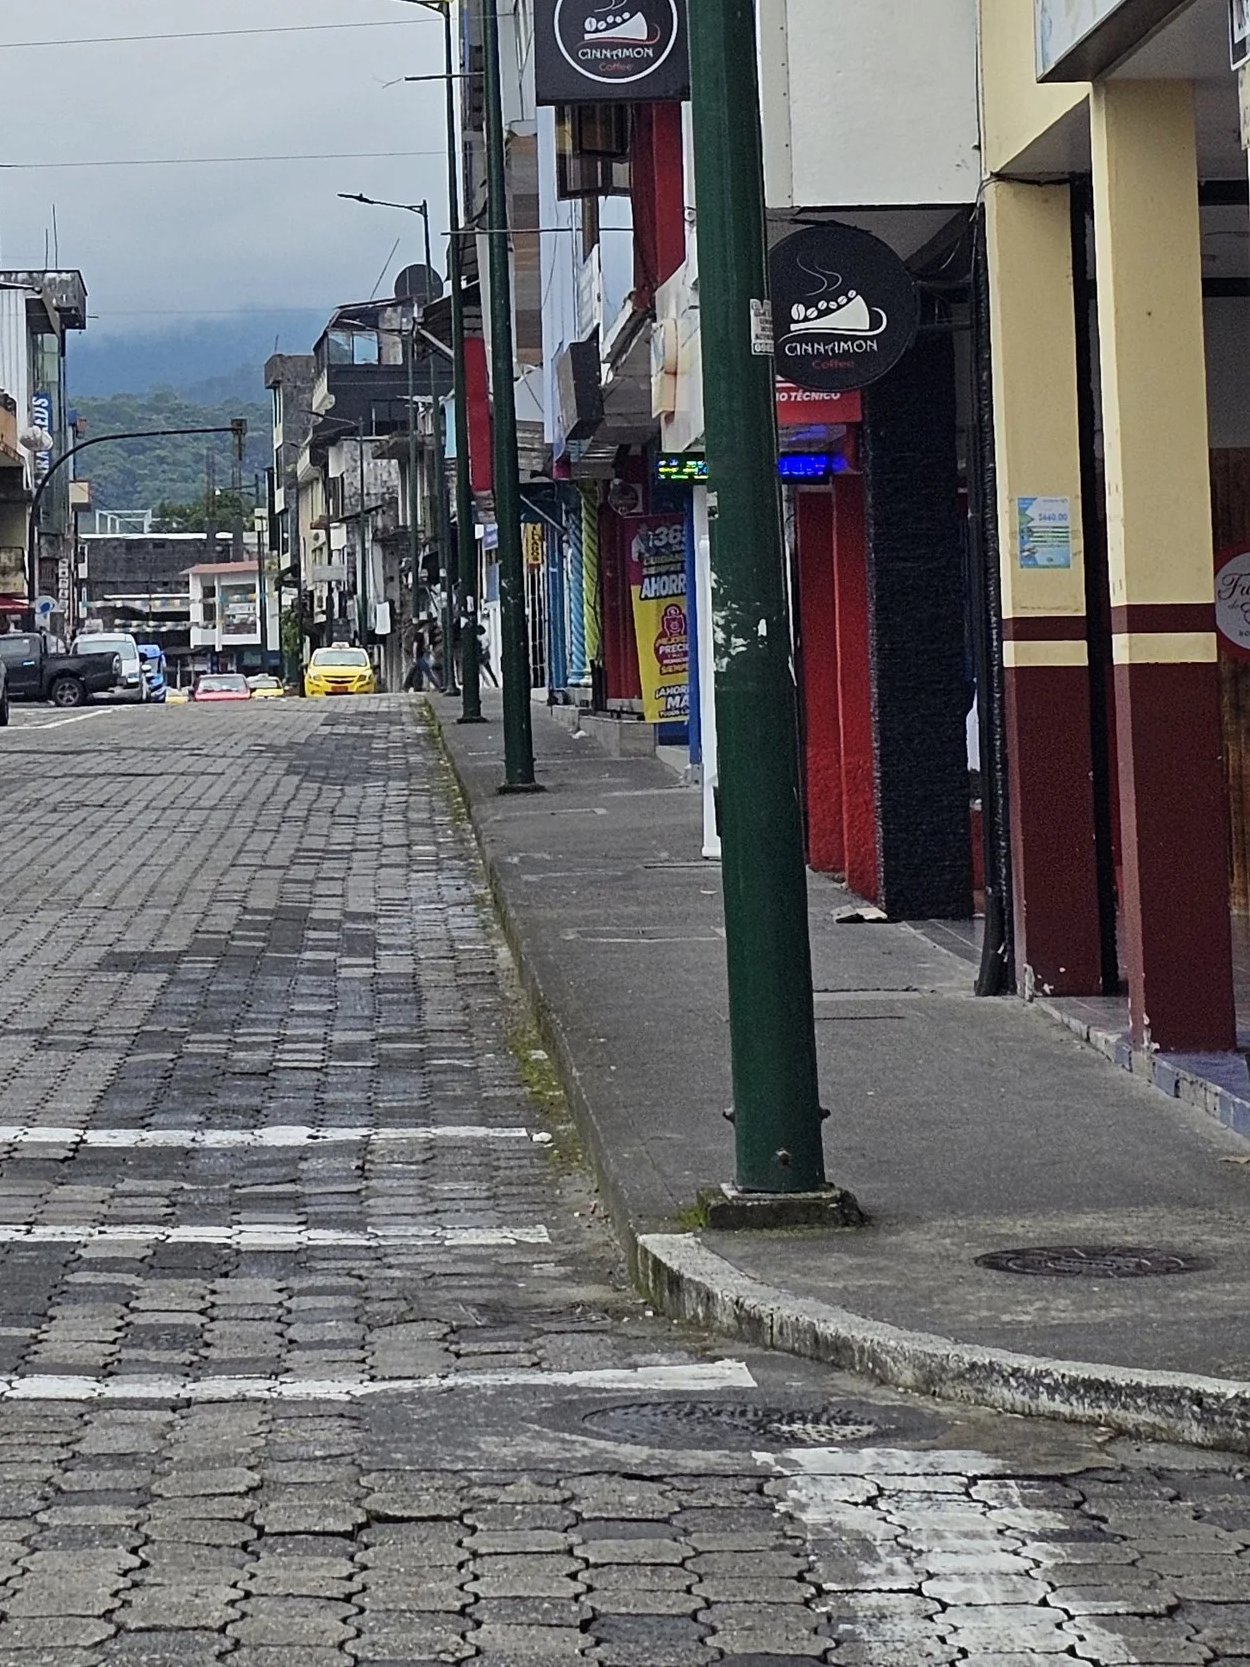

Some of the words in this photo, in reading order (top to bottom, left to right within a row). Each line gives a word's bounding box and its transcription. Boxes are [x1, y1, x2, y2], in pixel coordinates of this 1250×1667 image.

[578, 47, 654, 60] CINNAMON
[598, 61, 635, 72] Coffee
[784, 339, 879, 356] CINNAMON
[812, 359, 855, 370] Coffee
